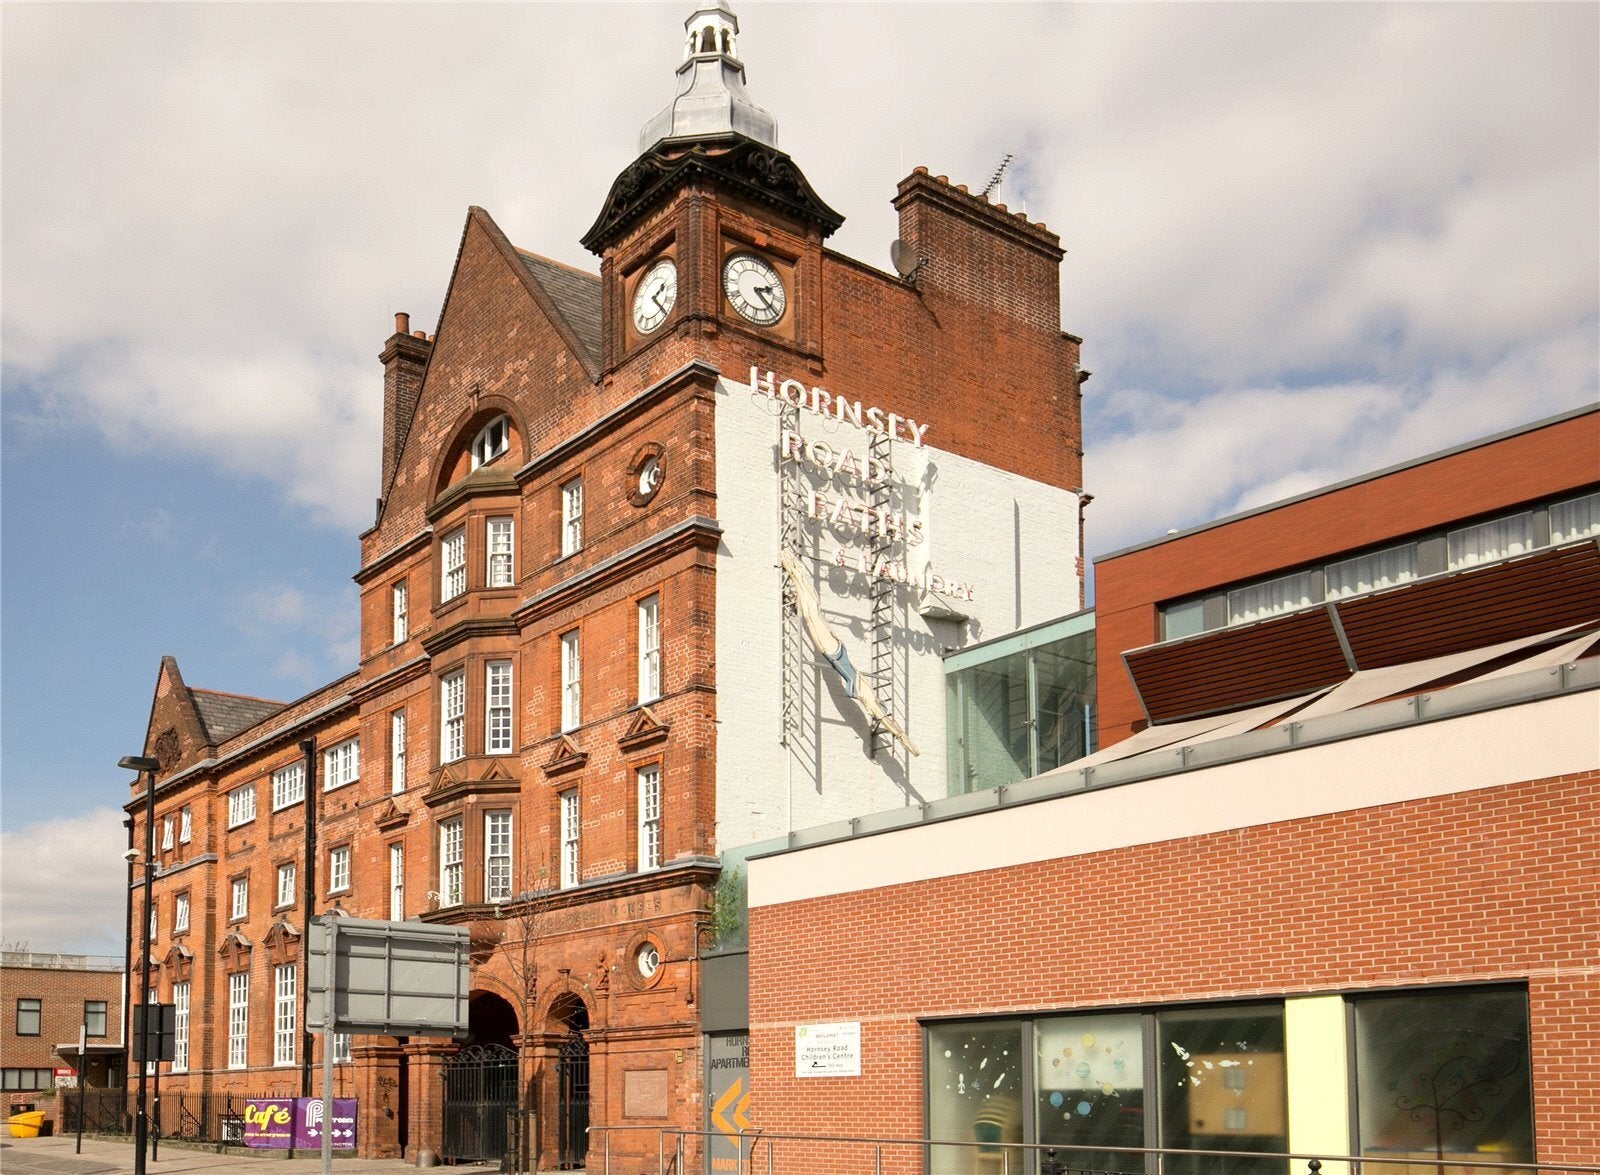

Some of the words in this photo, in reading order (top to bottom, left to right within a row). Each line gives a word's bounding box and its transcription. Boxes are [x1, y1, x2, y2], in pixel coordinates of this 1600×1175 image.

[750, 366, 929, 448] HORNSEY
[782, 429, 888, 484] ROAD
[808, 490, 924, 546] BATHS
[711, 1057, 749, 1069] APARTME
[245, 1105, 291, 1131] Café
